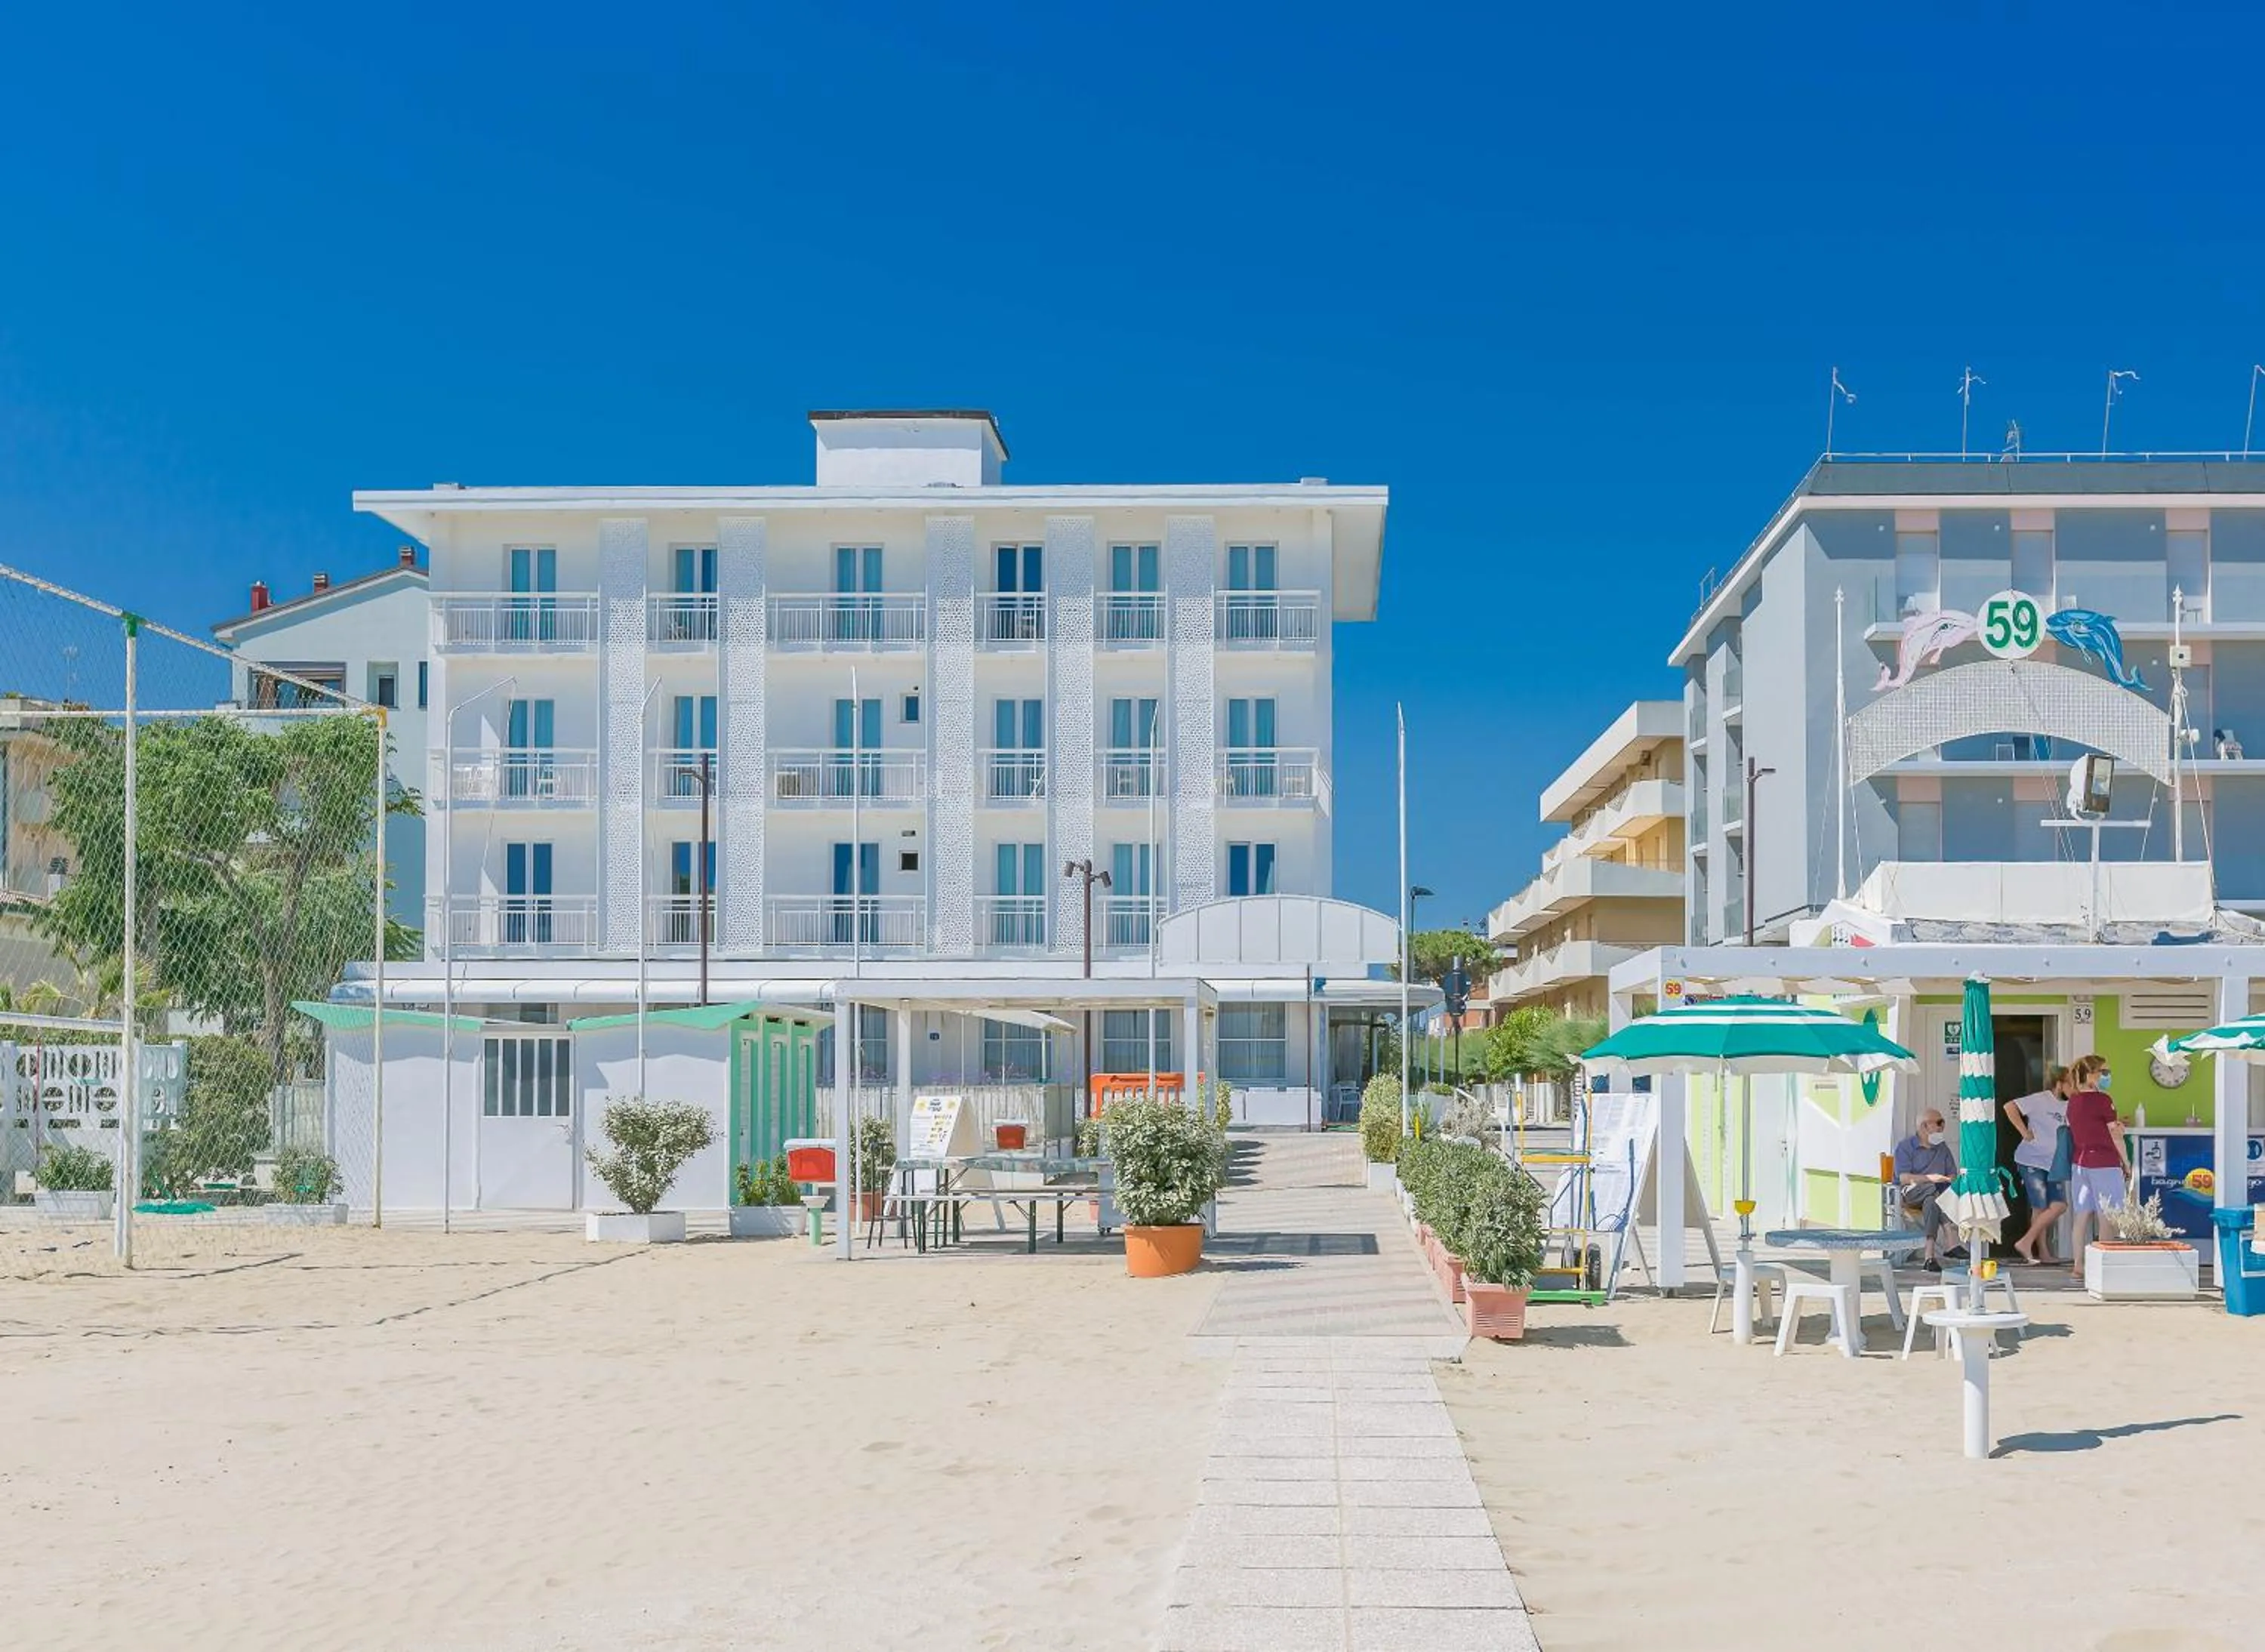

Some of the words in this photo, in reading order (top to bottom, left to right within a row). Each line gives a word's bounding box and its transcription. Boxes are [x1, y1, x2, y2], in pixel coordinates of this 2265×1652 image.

[1985, 600, 2038, 649] 59
[1666, 982, 1681, 995] 59
[2075, 1008, 2091, 1020] 59
[2192, 1173, 2213, 1188] 59
